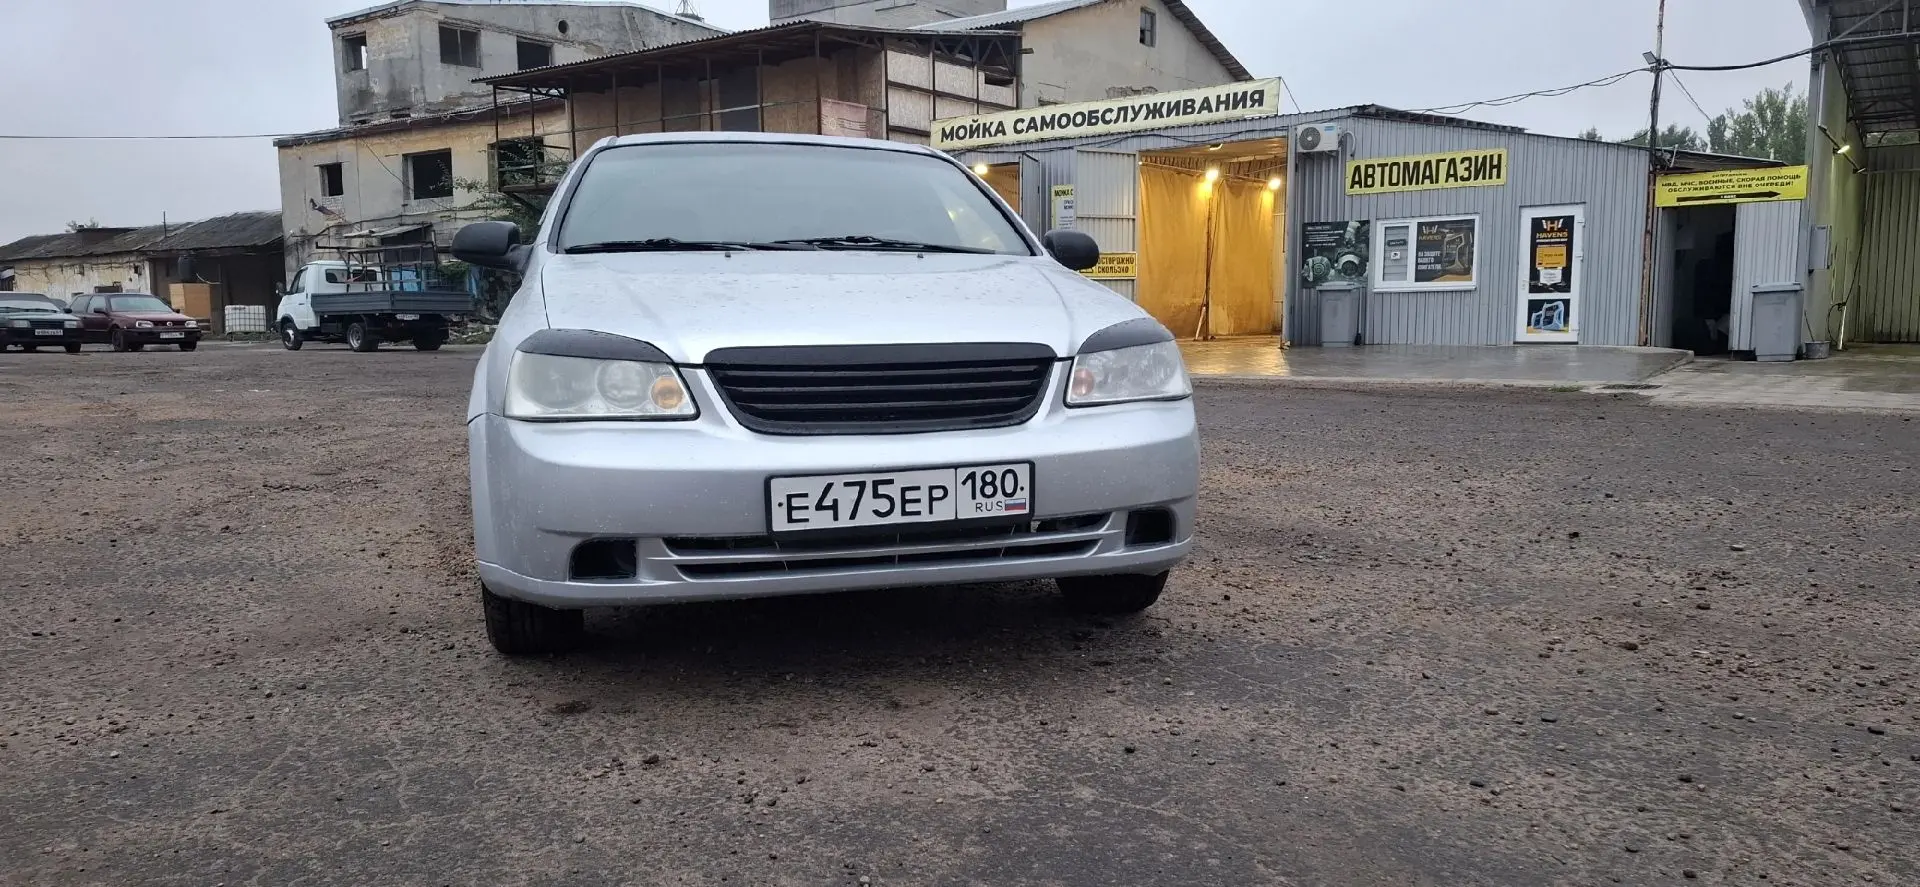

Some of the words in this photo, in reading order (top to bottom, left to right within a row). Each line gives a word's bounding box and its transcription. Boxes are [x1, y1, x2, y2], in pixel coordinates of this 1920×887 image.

[941, 119, 1007, 143] МОЙКА
[1013, 89, 1266, 135] САМООБСЛУЖИВАНИЯ
[1350, 153, 1503, 190] АВТОМАГАЗИН
[1667, 185, 1736, 193] ОБСЛУЖИВАЮТСЯ
[1536, 231, 1568, 239] HAVENS
[1098, 265, 1129, 274] СКОЛЬЗКО
[786, 478, 949, 524] Е475ЕР
[961, 468, 1019, 500] 180
[975, 500, 1003, 513] RUS
